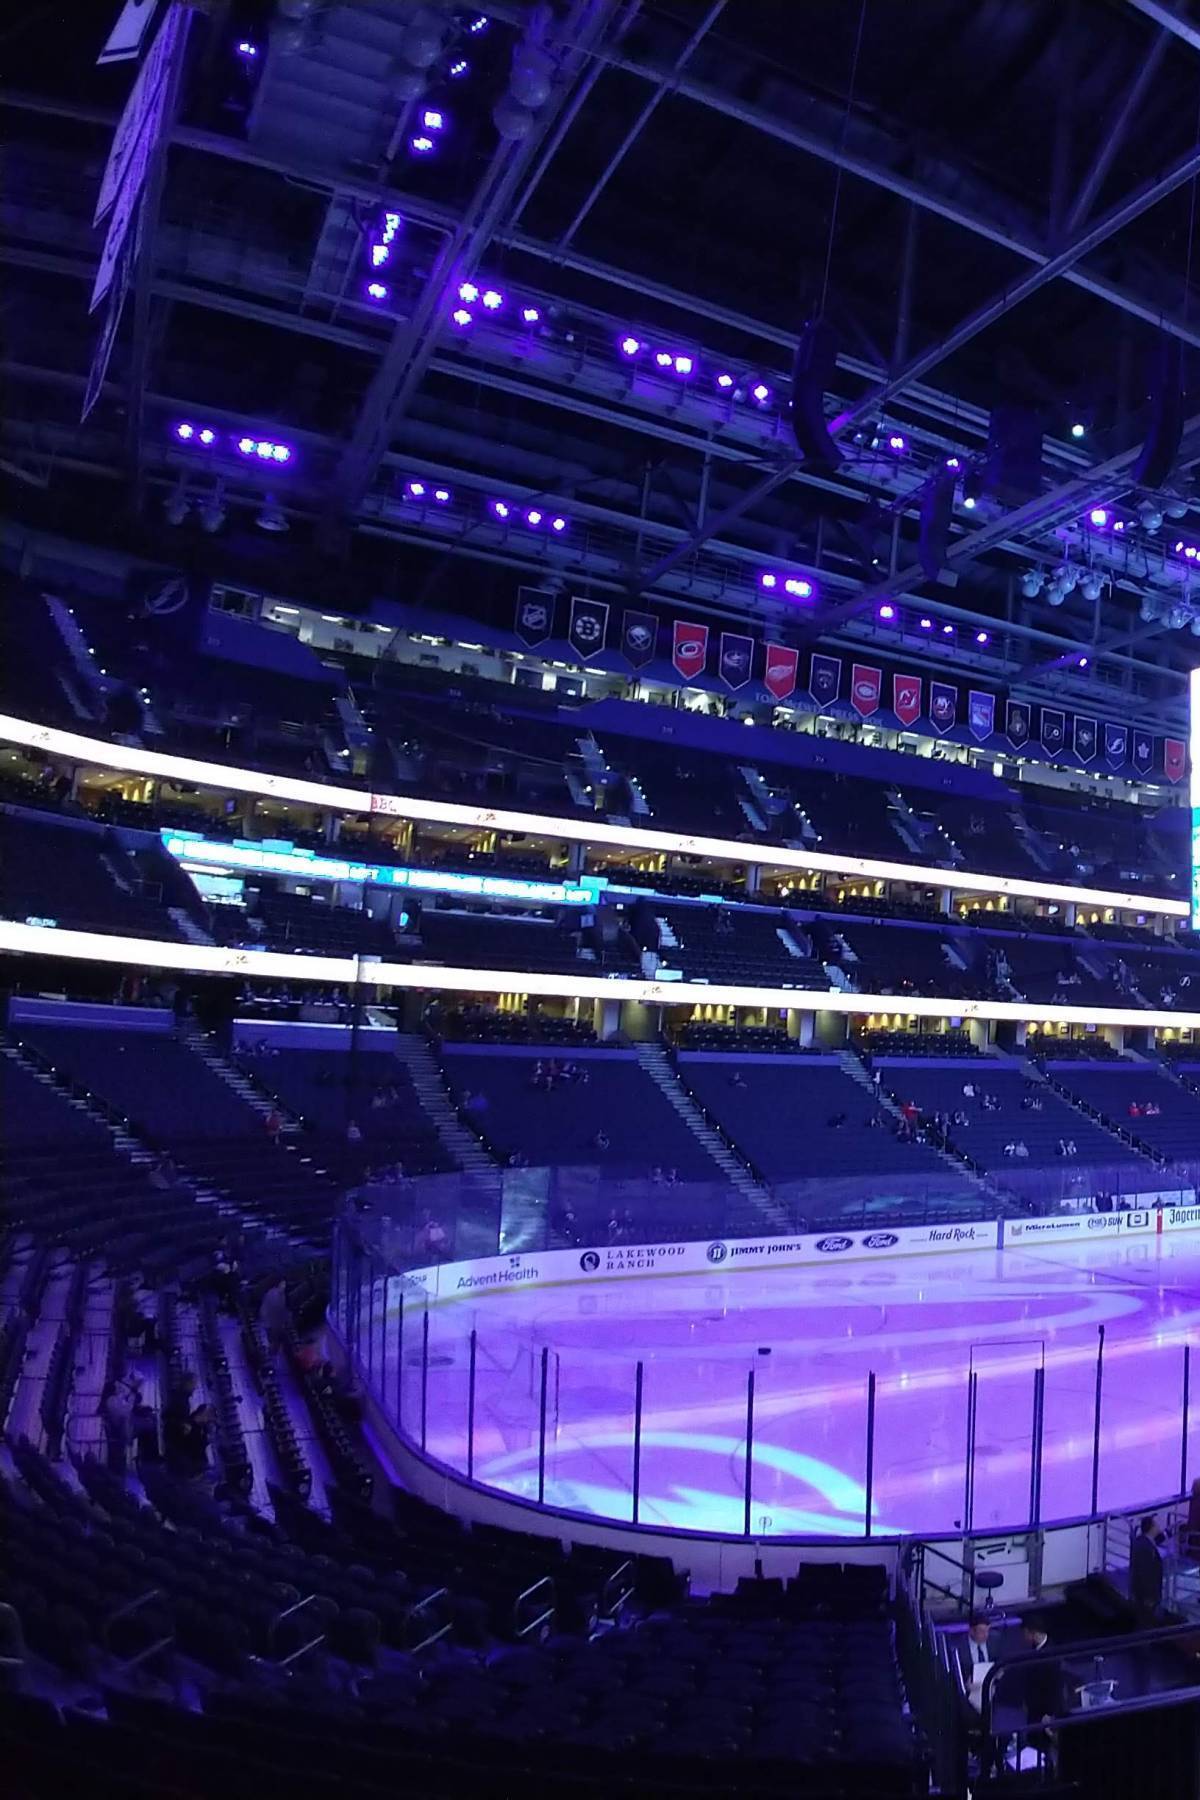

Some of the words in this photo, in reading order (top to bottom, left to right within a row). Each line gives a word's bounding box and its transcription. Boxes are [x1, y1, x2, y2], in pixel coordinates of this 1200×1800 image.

[929, 1228, 953, 1242] Hard
[953, 1227, 976, 1242] Rock
[606, 1247, 685, 1260] LAKEWOOD
[730, 1245, 765, 1257] JIMMY
[767, 1243, 802, 1255] JOHN'S
[606, 1259, 655, 1270] RANCH
